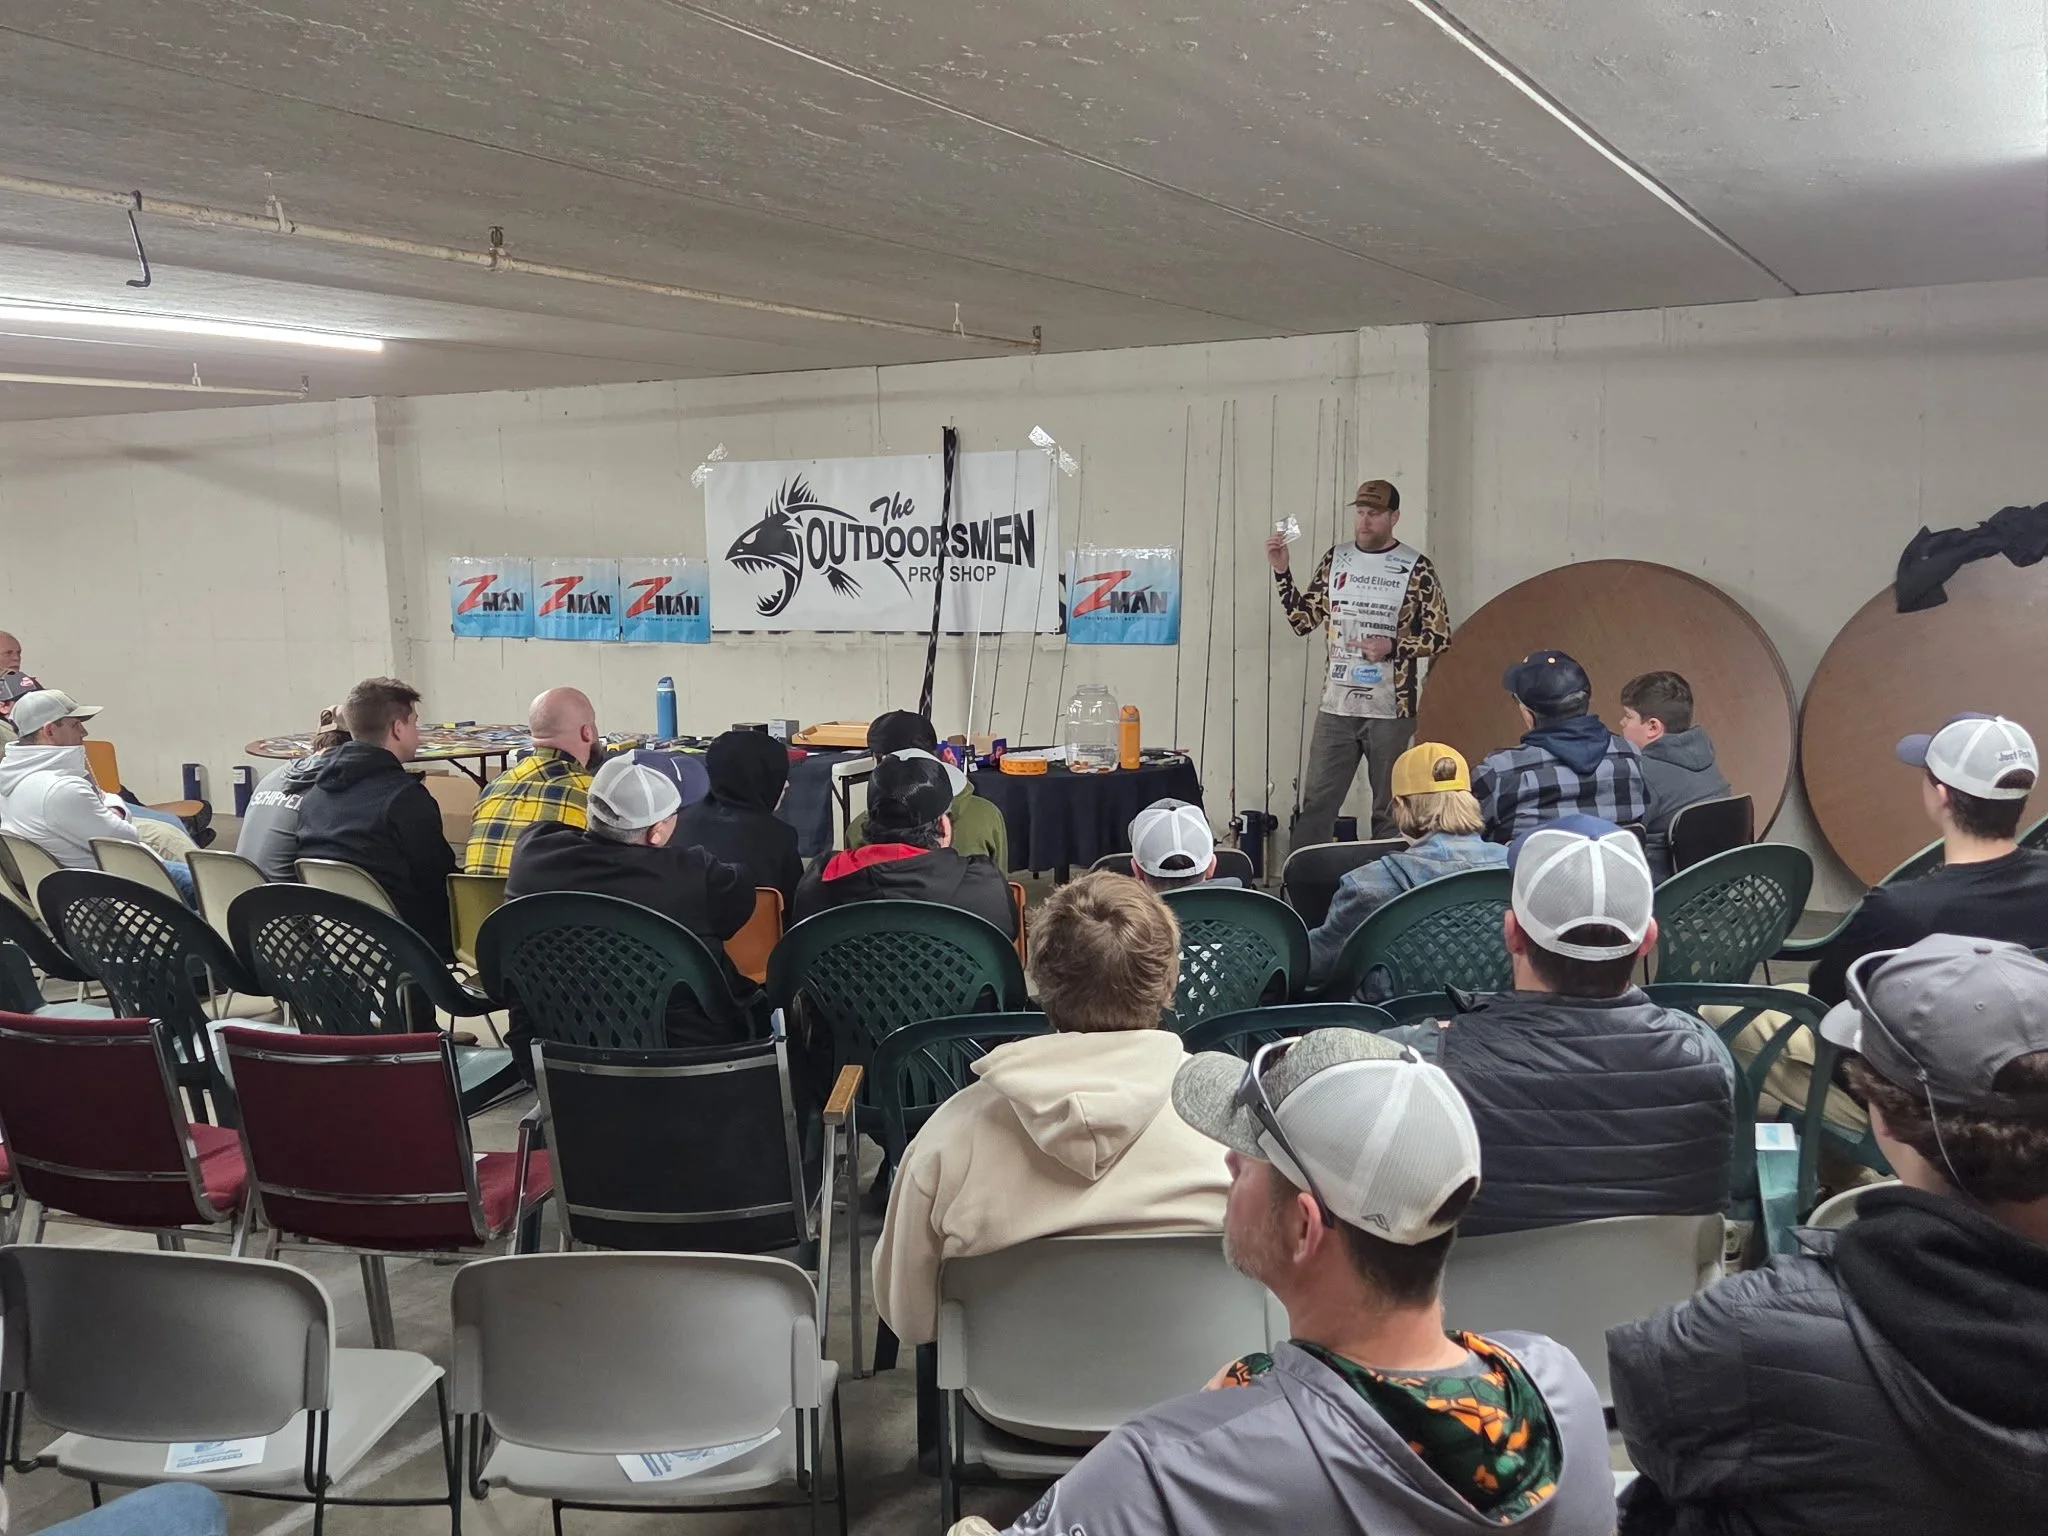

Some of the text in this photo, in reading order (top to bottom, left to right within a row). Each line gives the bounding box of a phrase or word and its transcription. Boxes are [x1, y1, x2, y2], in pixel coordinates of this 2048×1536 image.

[869, 491, 915, 526] The
[806, 509, 1036, 570] OUTDOORSMEN
[950, 565, 996, 582] SHOP
[1349, 574, 1401, 589] Todd Elliott
